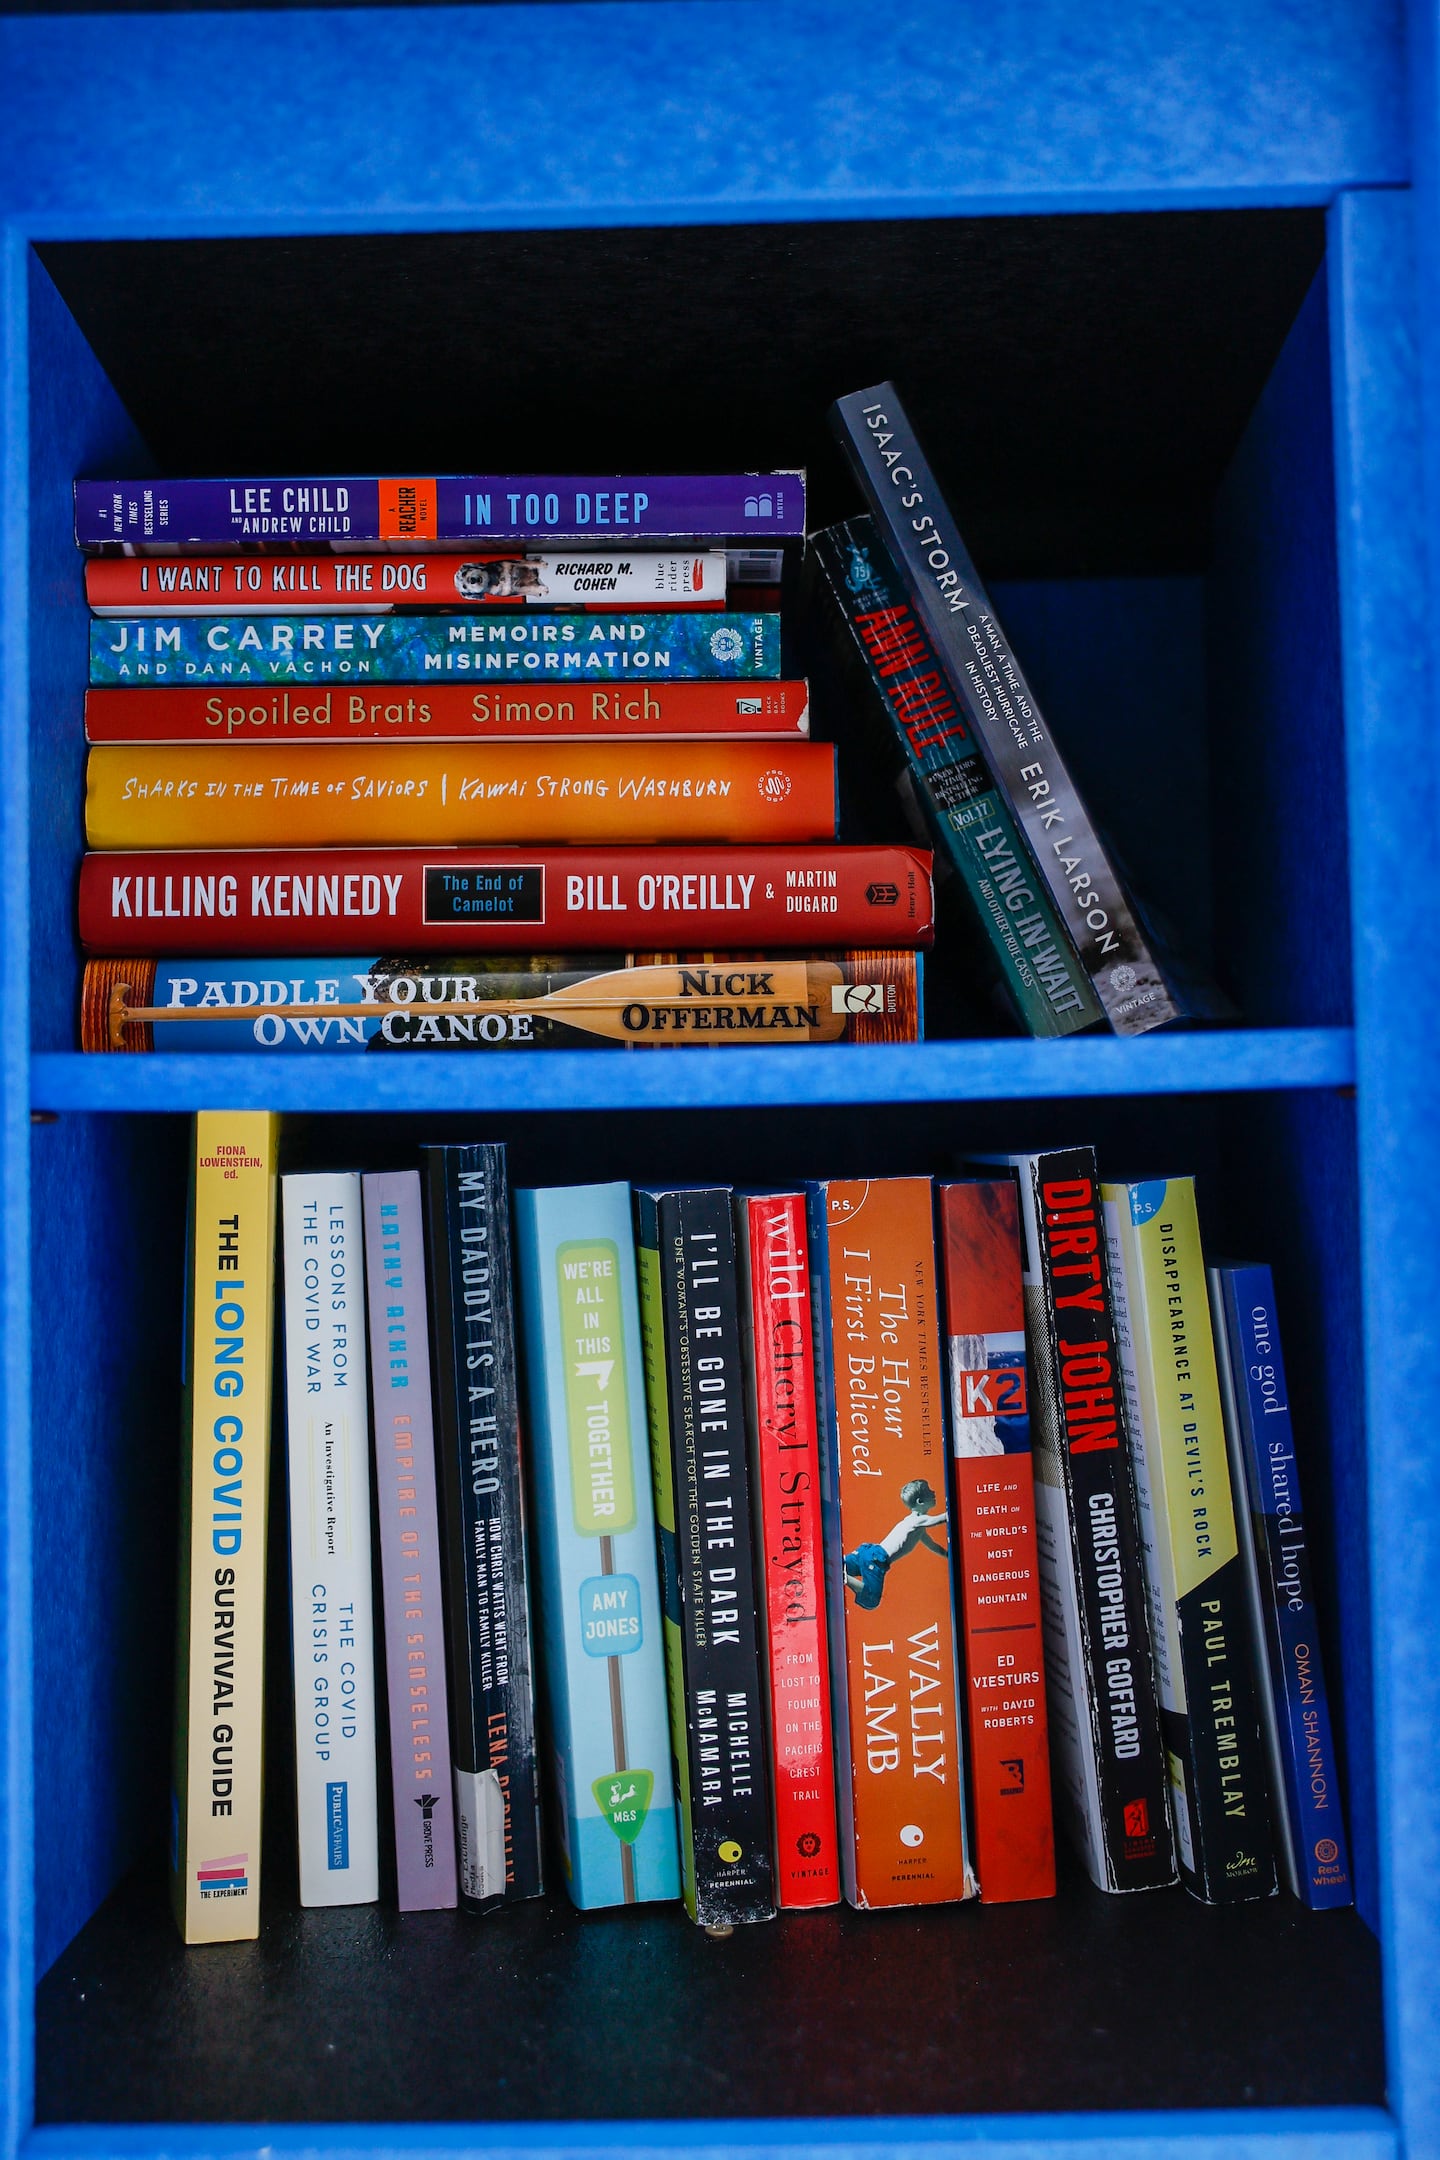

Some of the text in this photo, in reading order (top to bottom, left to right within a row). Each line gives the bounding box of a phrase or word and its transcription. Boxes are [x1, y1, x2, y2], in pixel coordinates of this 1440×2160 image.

[113, 493, 123, 533] NEW YORK
[128, 501, 138, 524] TIMES
[143, 490, 154, 535] BESTSELLING
[159, 499, 169, 526] SERIES
[229, 487, 349, 513] LEE CHILD
[399, 486, 416, 533] REACHER
[464, 492, 649, 525] IN TOO DEEP
[862, 403, 970, 613] ISAAC'S STORM
[231, 516, 351, 534] AND ANDREW CHILD
[141, 564, 426, 592] I WANT TO KILL THE DOG
[555, 563, 633, 577] RICHARD M.
[655, 563, 664, 590] blue
[668, 560, 677, 592] rider
[683, 560, 692, 592] press
[573, 578, 617, 592] COHEN
[110, 624, 386, 652] JIM CARREY
[449, 624, 646, 643] MEMOIRS AND
[754, 618, 763, 669] VINTAGE
[854, 604, 930, 678] ANN
[119, 660, 370, 675] AND DANA VACHON
[424, 651, 671, 670] MISINFORMATION
[967, 625, 1028, 750] DEADLIEST HURRICANE
[205, 689, 661, 734] Spoiled Brats Simon Rich
[888, 672, 966, 758] RULE
[1020, 762, 1120, 954] ERIK LARSON
[443, 875, 524, 891] The End of
[567, 874, 756, 910] BILL O'REILLY
[786, 870, 837, 888] MARTIN
[111, 875, 403, 917] KILLING KENNEDY
[452, 896, 514, 913] Camelot
[786, 895, 838, 913] DUGARD
[908, 870, 916, 919] Henry Holt
[975, 826, 1084, 1016] LYING IN WAIT
[887, 984, 896, 1013] DUTTON
[200, 1157, 263, 1169] LOWENSTEIN,
[216, 1146, 246, 1156] FIONA
[831, 1200, 854, 1211] P.S.
[1134, 1203, 1155, 1213] P.S.
[1042, 1178, 1105, 1313] DIRTY
[563, 1260, 612, 1281] WE'RE
[303, 1200, 322, 1394] THE COVID WAR
[329, 1205, 348, 1387] LESSONS FROM
[380, 1204, 408, 1388] KATHY ACKER
[575, 1287, 604, 1305] ALL
[457, 1170, 500, 1495] MY DADDY IS A HERO
[583, 1312, 599, 1329] IN
[575, 1336, 611, 1356] THIS
[843, 1247, 883, 1477] I First Believed
[879, 1283, 910, 1439] The Hour
[965, 1372, 1022, 1414] K2
[1059, 1340, 1118, 1455] JOHN
[1160, 1223, 1212, 1558] DISAPPEARANCE AT DEVIL'S ROCK
[766, 1212, 816, 1625] wild Cheryl Strayed
[690, 1233, 740, 1646] I'LL BE GONE IN THE DARK
[585, 1400, 616, 1517] TOGETHER
[1250, 1305, 1305, 1613] one god shared hope
[976, 1483, 1000, 1494] LIFE
[212, 1215, 245, 1817] THE LONG COVID SURVIVAL GUIDE
[976, 1506, 1008, 1516] DEATH
[970, 1525, 1028, 1539] THE WORLD'S
[987, 1549, 1014, 1559] MOST
[972, 1570, 1030, 1583] DANGEROUS
[592, 1590, 628, 1611] AMY
[977, 1592, 1028, 1605] MOUNTAIN
[586, 1616, 639, 1640] JONES
[1088, 1492, 1140, 1760] CHRISTOPHER GOFFARD
[997, 1654, 1015, 1667] ED
[972, 1671, 1040, 1689] VIESTURS
[862, 1639, 900, 1775] LAMB
[907, 1621, 946, 1785] WALLY
[981, 1698, 1035, 1713] WITH DAVID
[1200, 1600, 1246, 1817] PAUL TREMBLAY
[984, 1715, 1034, 1729] ROBERTS
[1294, 1643, 1329, 1810] OMAN SHANNON
[696, 1690, 722, 1807] McNAMARA
[727, 1693, 752, 1797] MICHELLE
[613, 1809, 637, 1824] M&S
[791, 1868, 830, 1879] VINTAGE
[1318, 1865, 1340, 1875] Red
